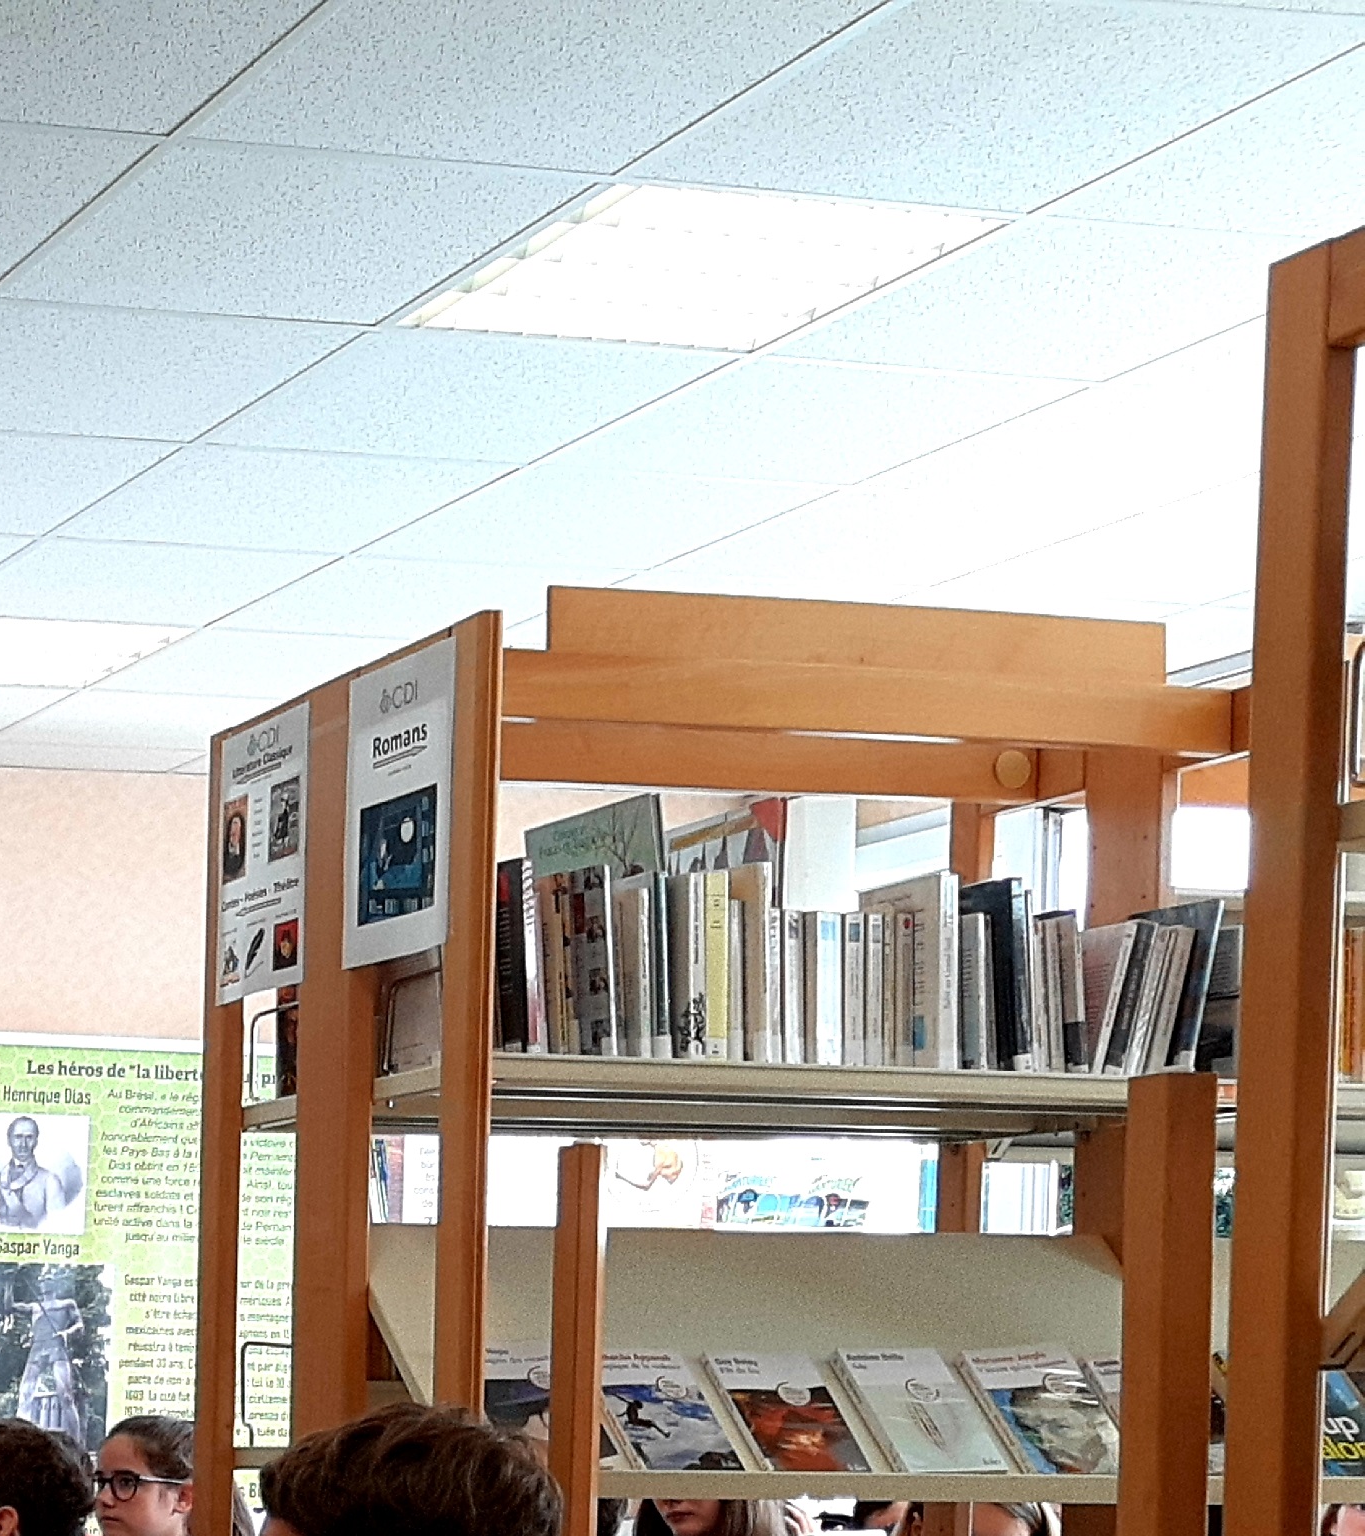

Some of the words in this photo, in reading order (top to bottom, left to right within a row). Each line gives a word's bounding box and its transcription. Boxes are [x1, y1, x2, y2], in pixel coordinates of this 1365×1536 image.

[392, 679, 418, 710] CDI
[372, 720, 428, 759] Romans
[25, 1059, 55, 1075] Les
[57, 1060, 104, 1077] héros
[105, 1062, 127, 1078] de
[3, 1086, 61, 1106] Henrique
[63, 1087, 91, 1105] Dias
[42, 1239, 80, 1258] Yanga
